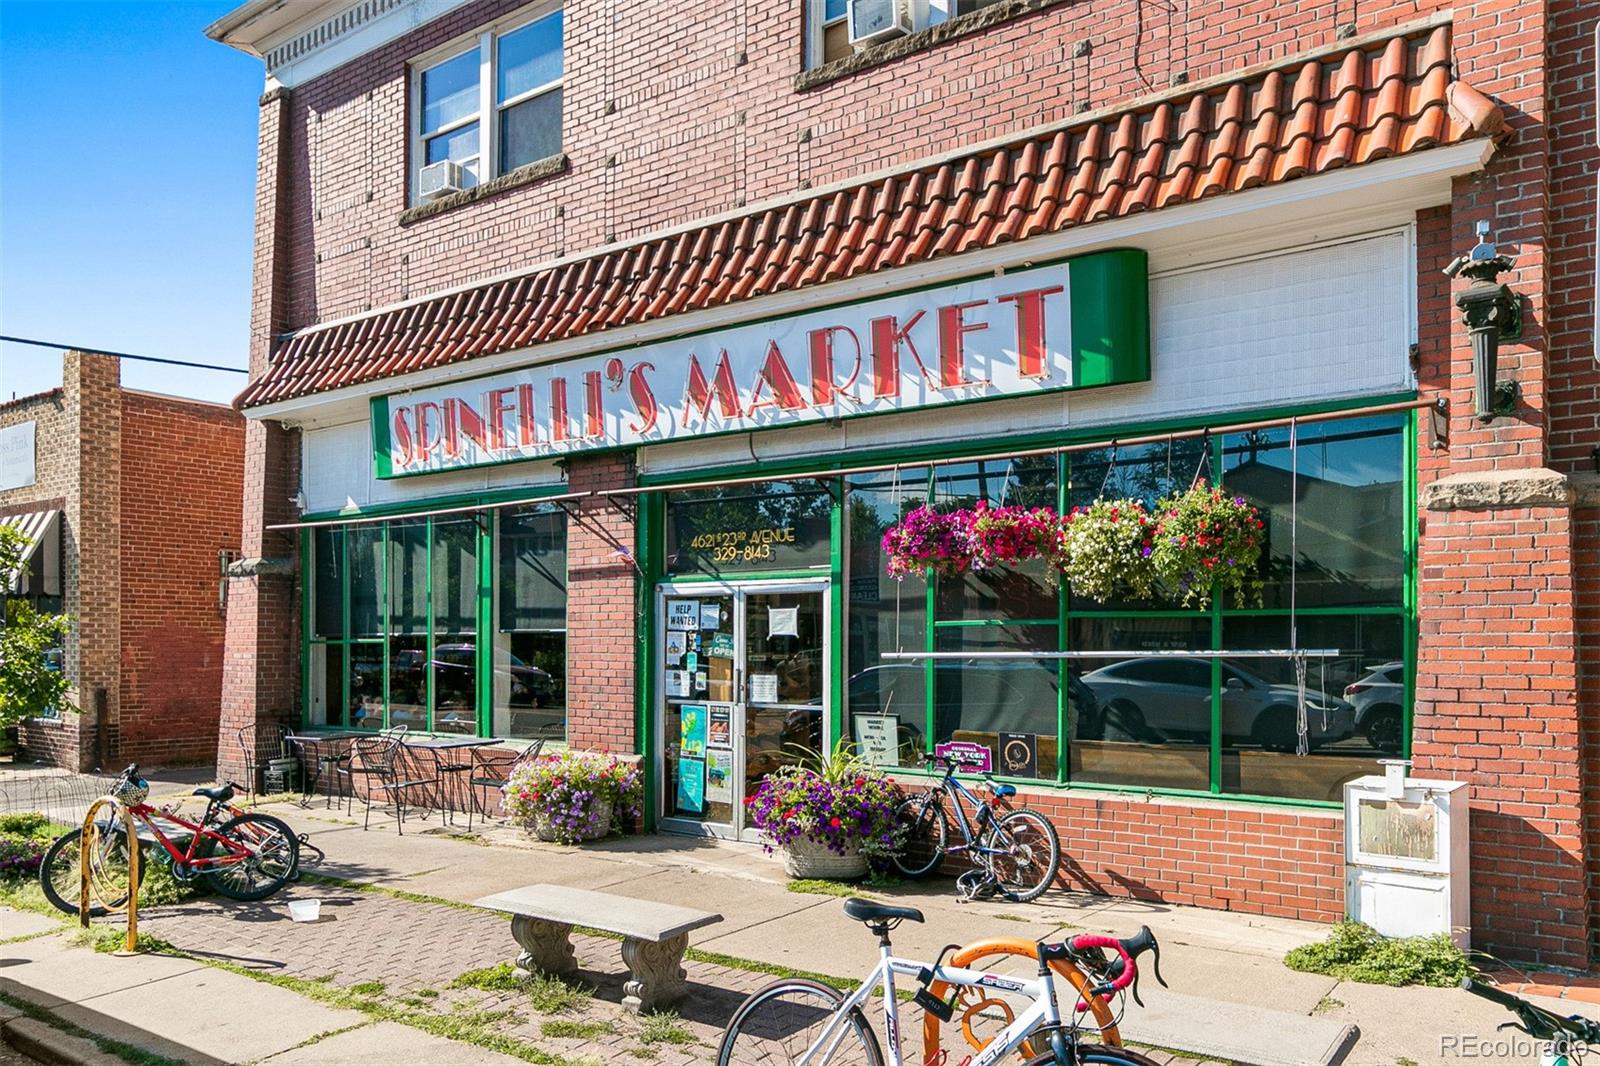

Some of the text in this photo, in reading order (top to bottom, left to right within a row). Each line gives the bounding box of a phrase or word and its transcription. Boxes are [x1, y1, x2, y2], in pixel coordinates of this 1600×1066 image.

[393, 284, 1065, 467] SPINELLI'S MARKET
[691, 534, 715, 548] 4621
[750, 527, 795, 544] AVENUE
[713, 543, 770, 561] 329-8143
[675, 604, 692, 614] HELP
[670, 615, 696, 626] WANTED
[963, 751, 987, 760] YORK
